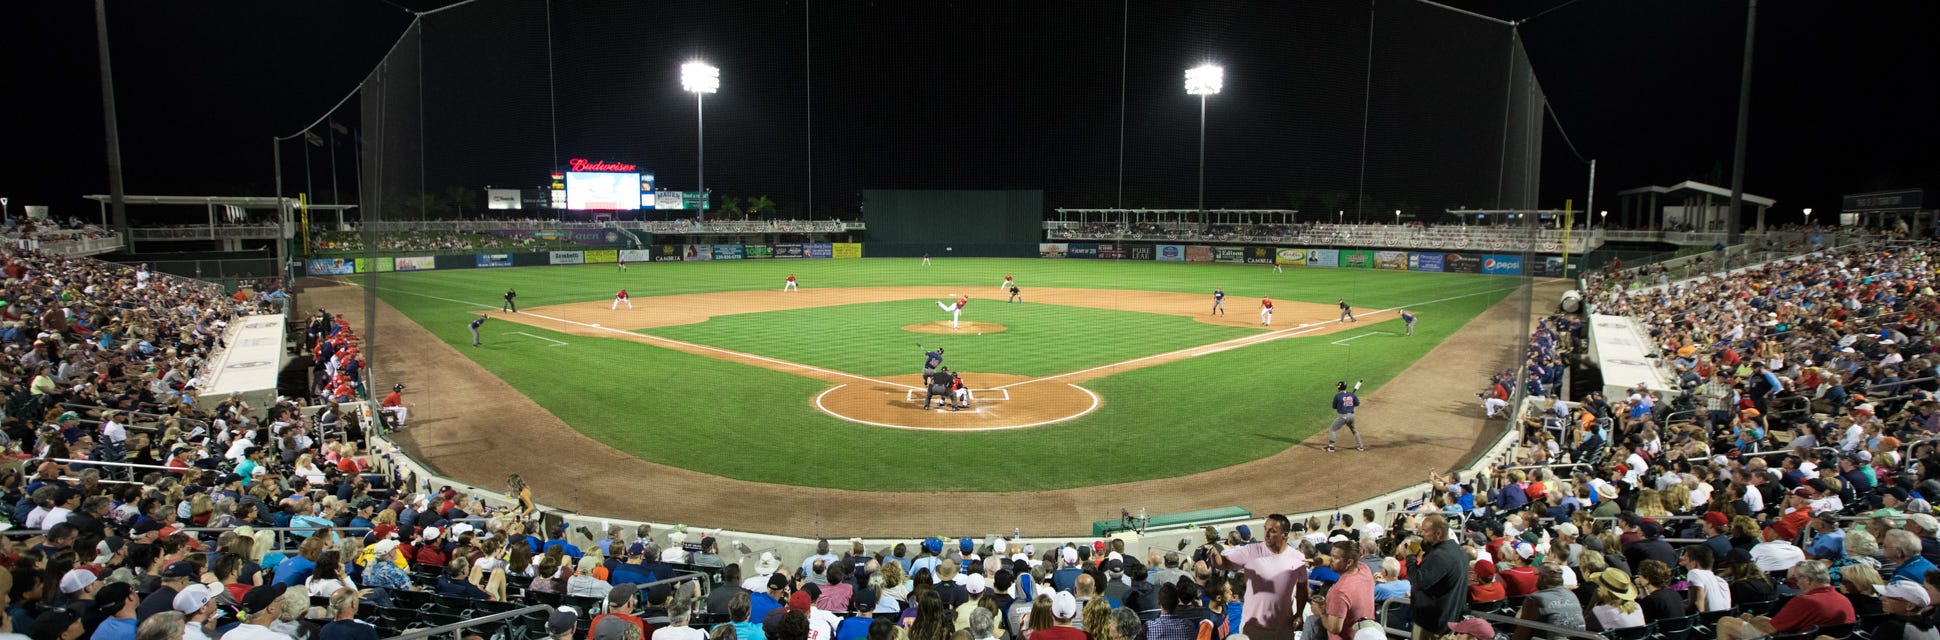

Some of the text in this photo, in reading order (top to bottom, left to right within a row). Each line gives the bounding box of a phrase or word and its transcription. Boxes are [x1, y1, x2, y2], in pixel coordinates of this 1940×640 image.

[569, 158, 637, 172] Budweiser
[568, 231, 599, 240] Lawn
[1496, 262, 1520, 272] pepsi
